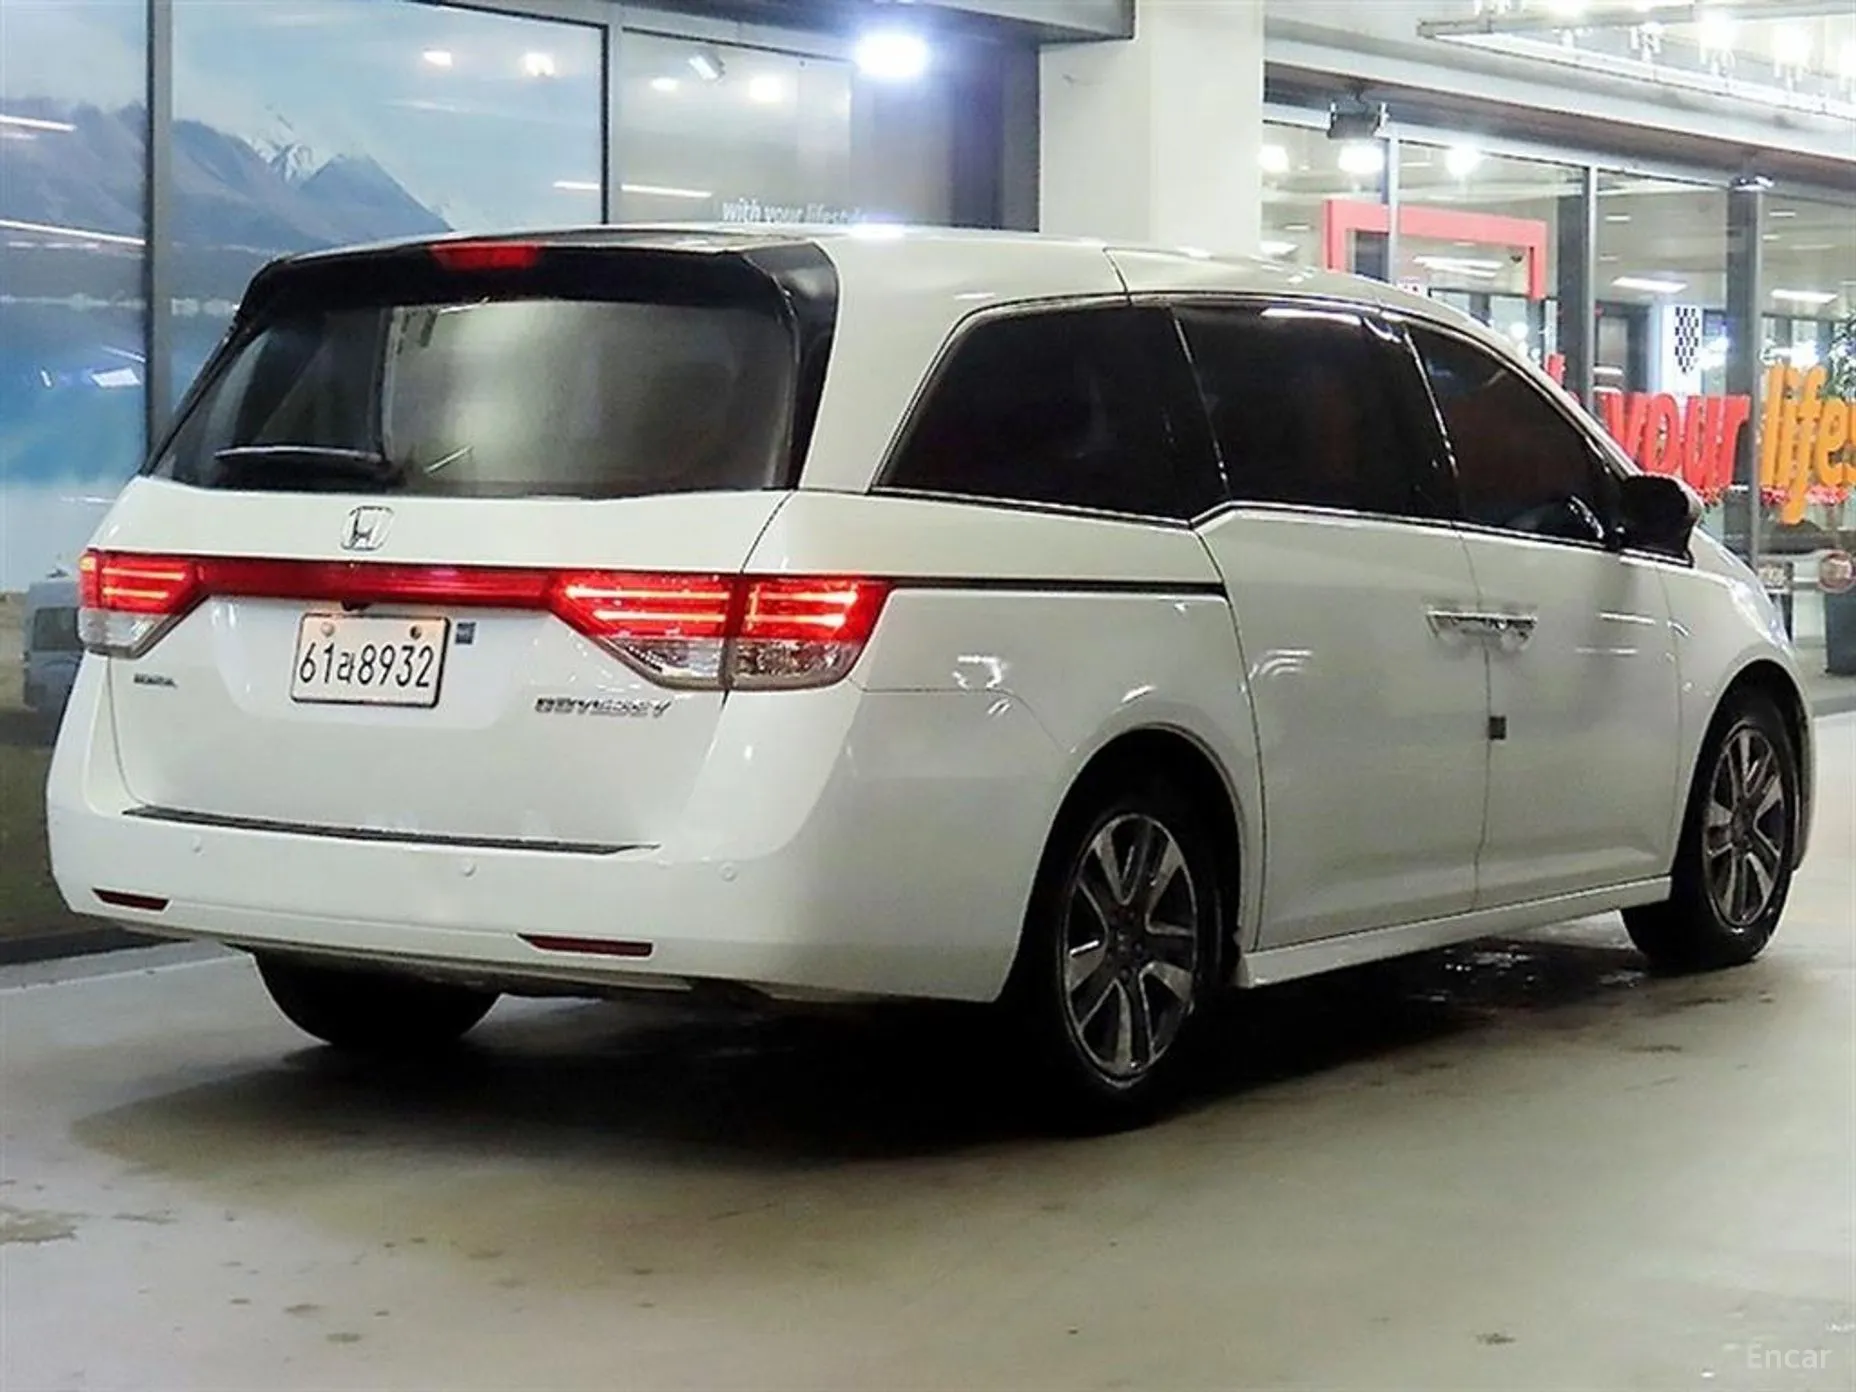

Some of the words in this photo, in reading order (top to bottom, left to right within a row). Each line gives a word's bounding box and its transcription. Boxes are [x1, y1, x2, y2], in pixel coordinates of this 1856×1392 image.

[722, 198, 762, 222] with
[1600, 390, 1751, 492] your
[299, 641, 434, 688] 61라8932
[535, 698, 671, 718] ODYSSEY
